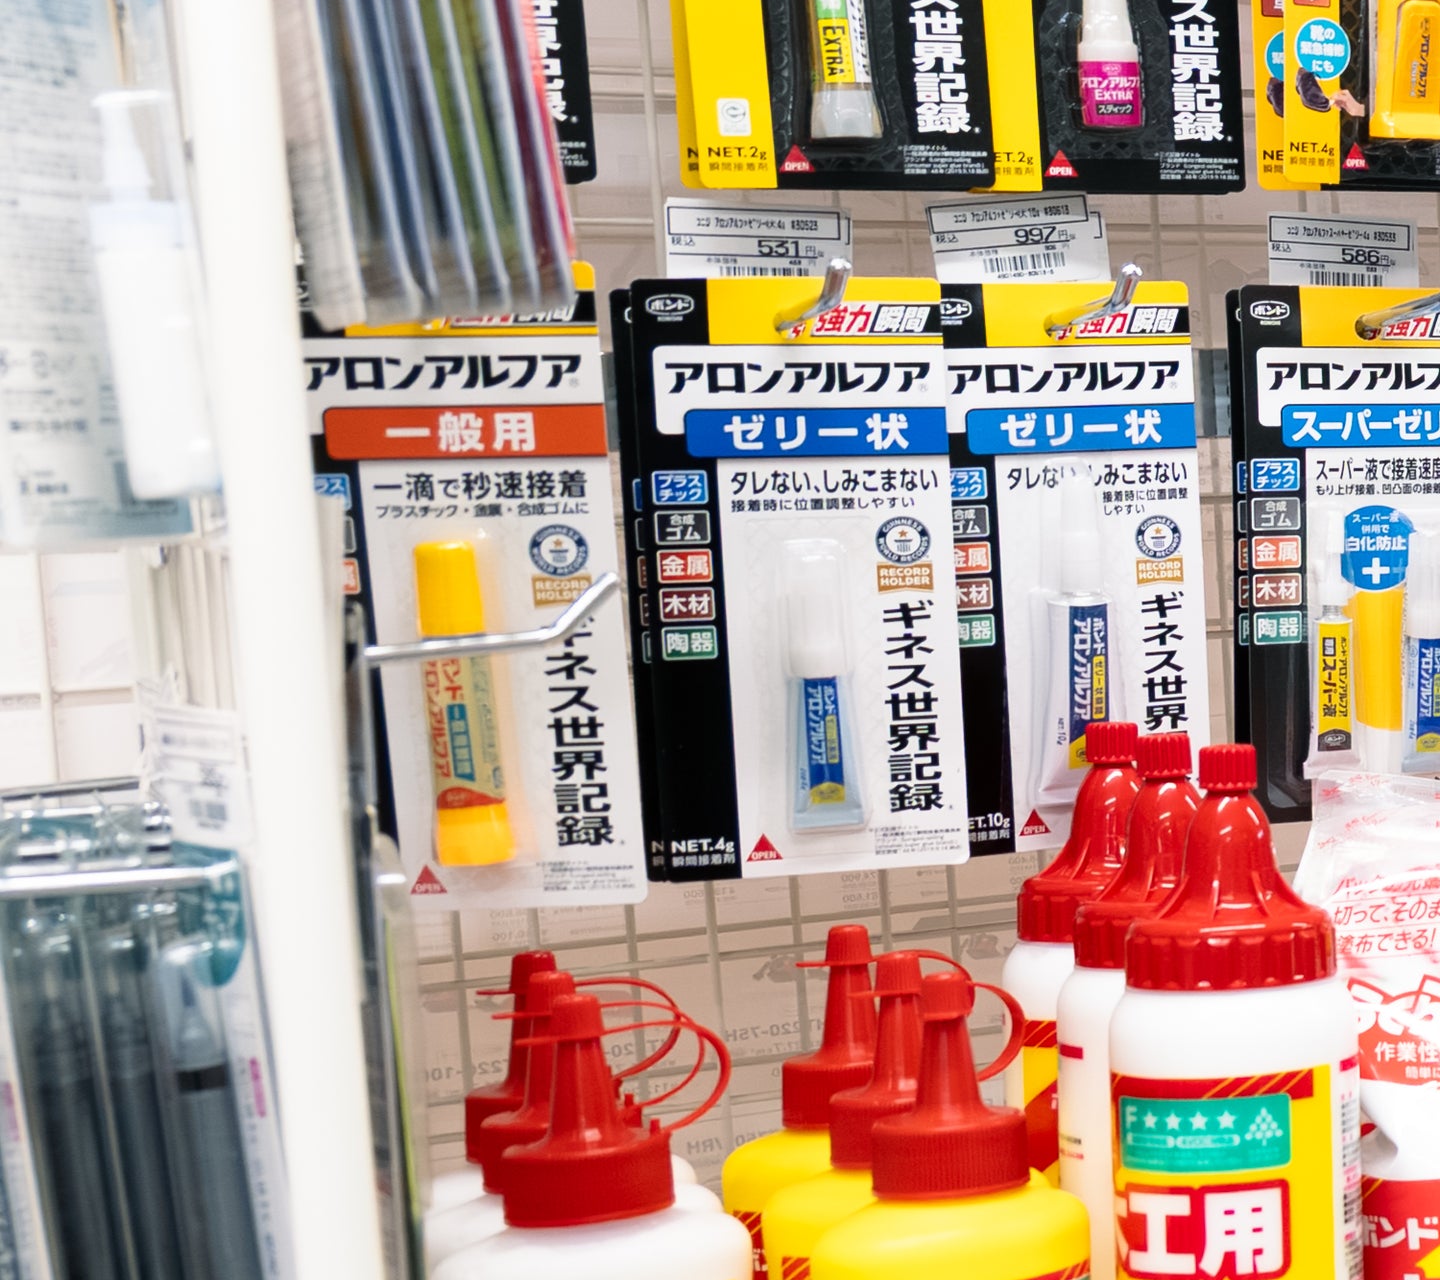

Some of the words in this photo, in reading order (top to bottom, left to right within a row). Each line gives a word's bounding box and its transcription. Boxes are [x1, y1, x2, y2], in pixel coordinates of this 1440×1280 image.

[757, 240, 801, 259] 531
[1015, 226, 1056, 244] 997
[1342, 248, 1380, 264] 586
[386, 411, 534, 453] 一般用
[725, 413, 908, 451] ゼリー状
[1000, 410, 1162, 446] ゼリー状
[374, 471, 588, 501] 一滴で秒速接着
